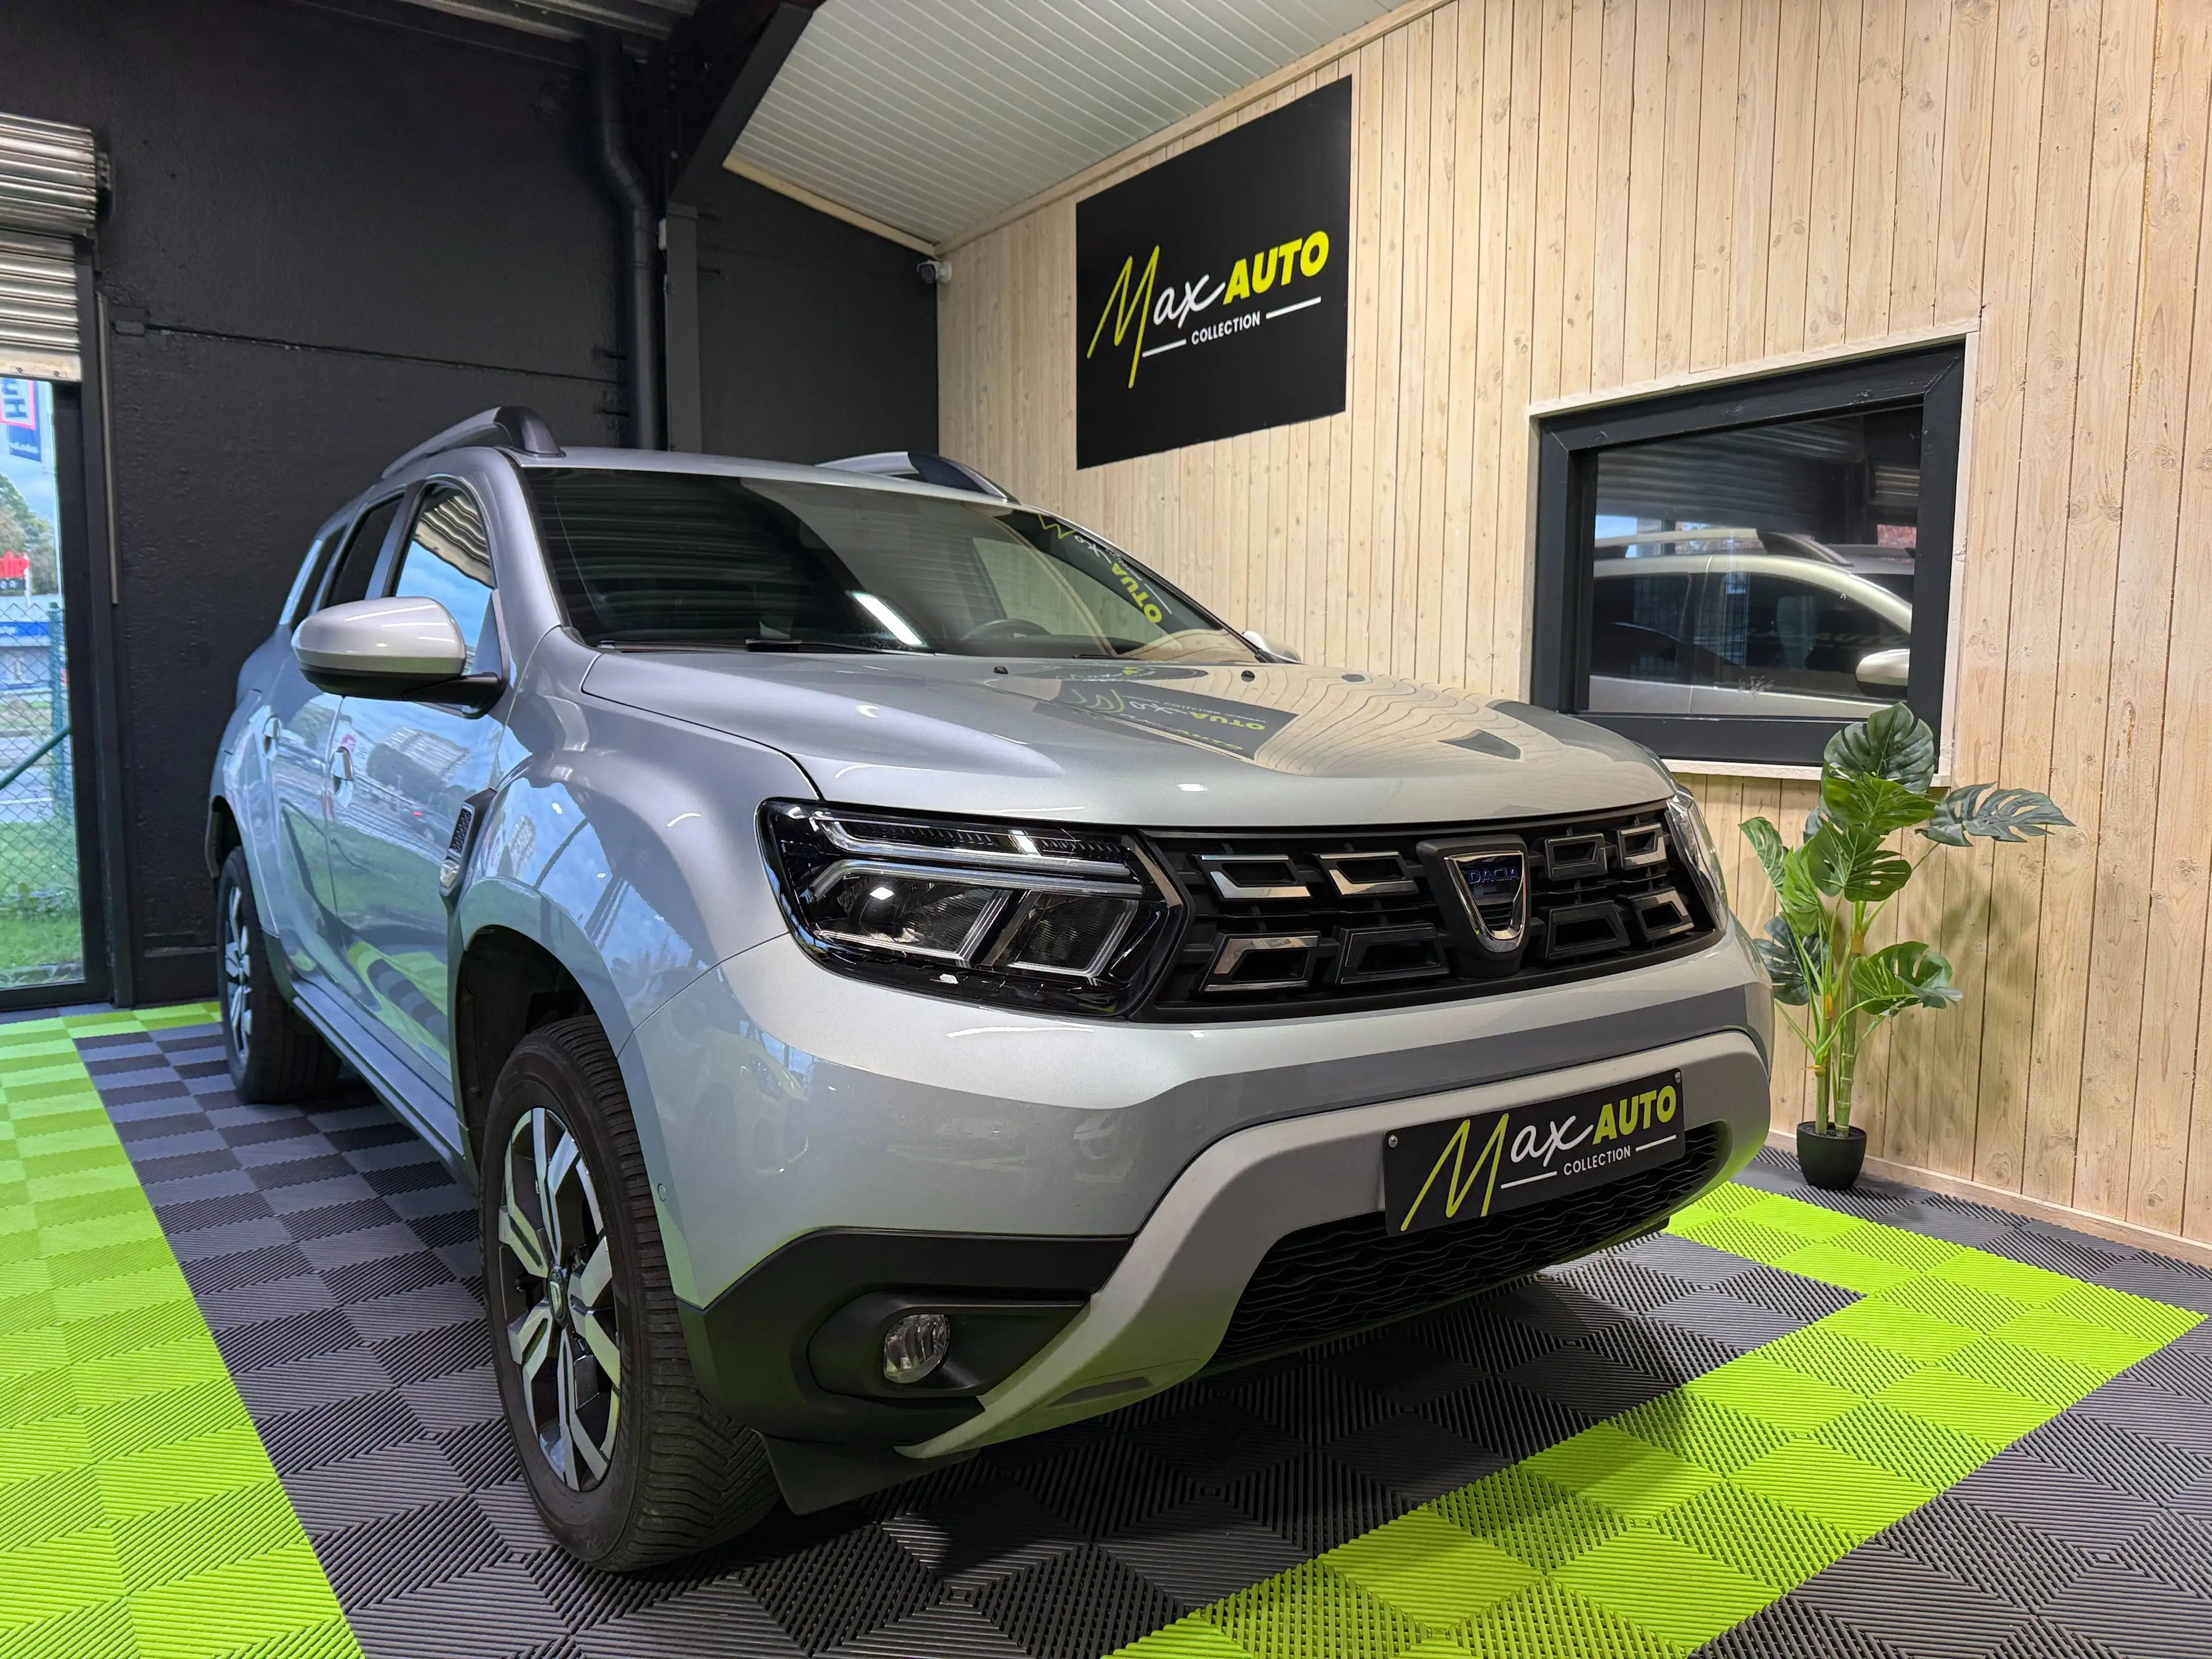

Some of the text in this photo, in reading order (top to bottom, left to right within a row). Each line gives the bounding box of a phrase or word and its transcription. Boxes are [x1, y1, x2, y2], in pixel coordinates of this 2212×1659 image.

[1087, 231, 1330, 388] Max AUTO
[1191, 311, 1260, 344] COLLECTION
[1468, 866, 1520, 884] DACIA
[1400, 1085, 1676, 1232] Max AUTO
[1563, 1145, 1631, 1176] COLLECTION
